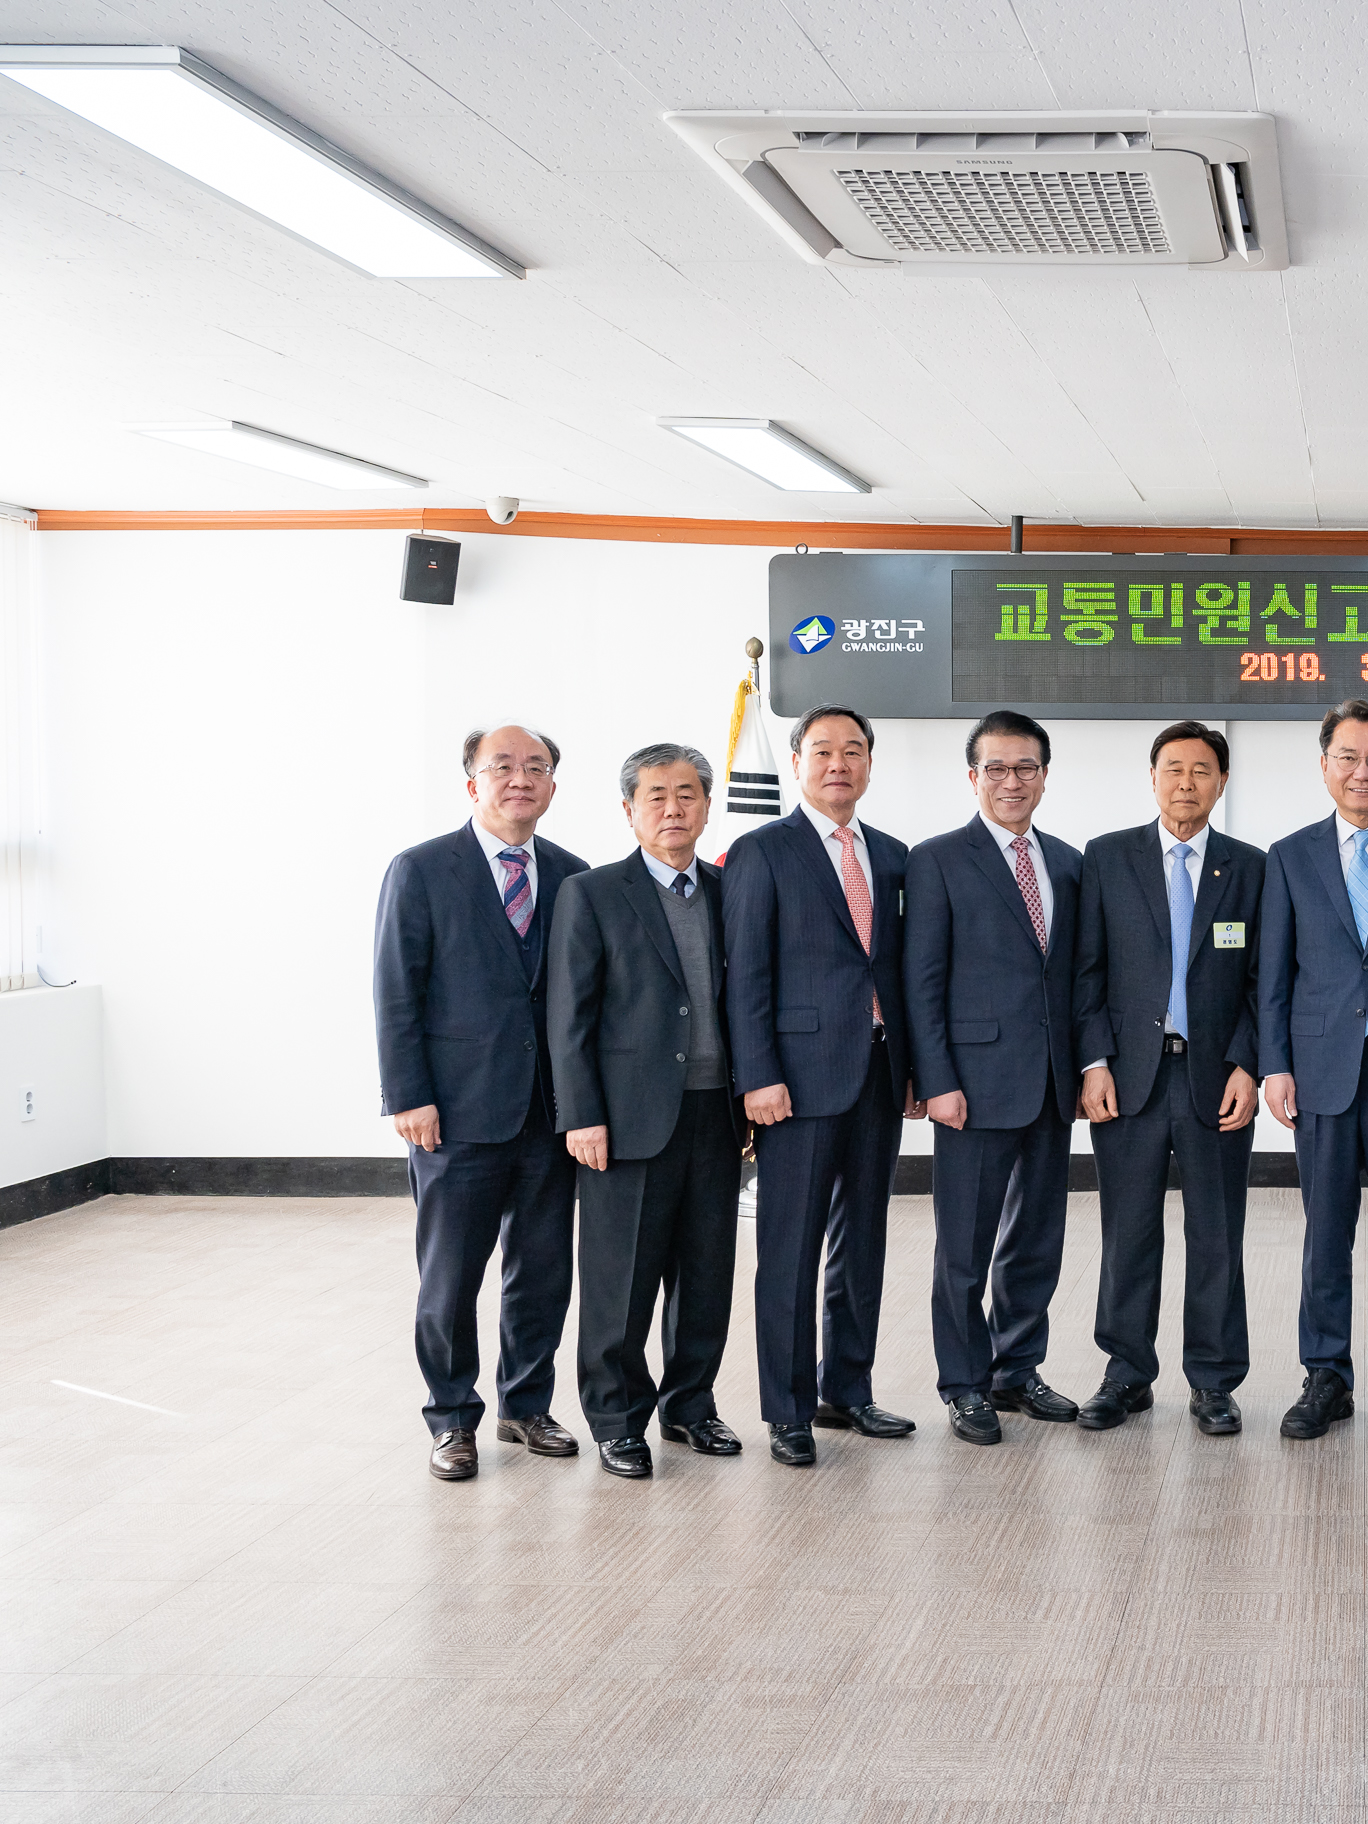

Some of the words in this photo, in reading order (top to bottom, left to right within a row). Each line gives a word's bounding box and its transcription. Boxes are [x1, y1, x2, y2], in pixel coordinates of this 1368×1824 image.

[840, 619, 926, 640] 광진구
[841, 642, 924, 652] GWANGJIN-GU
[1240, 652, 1326, 682] 2019.
